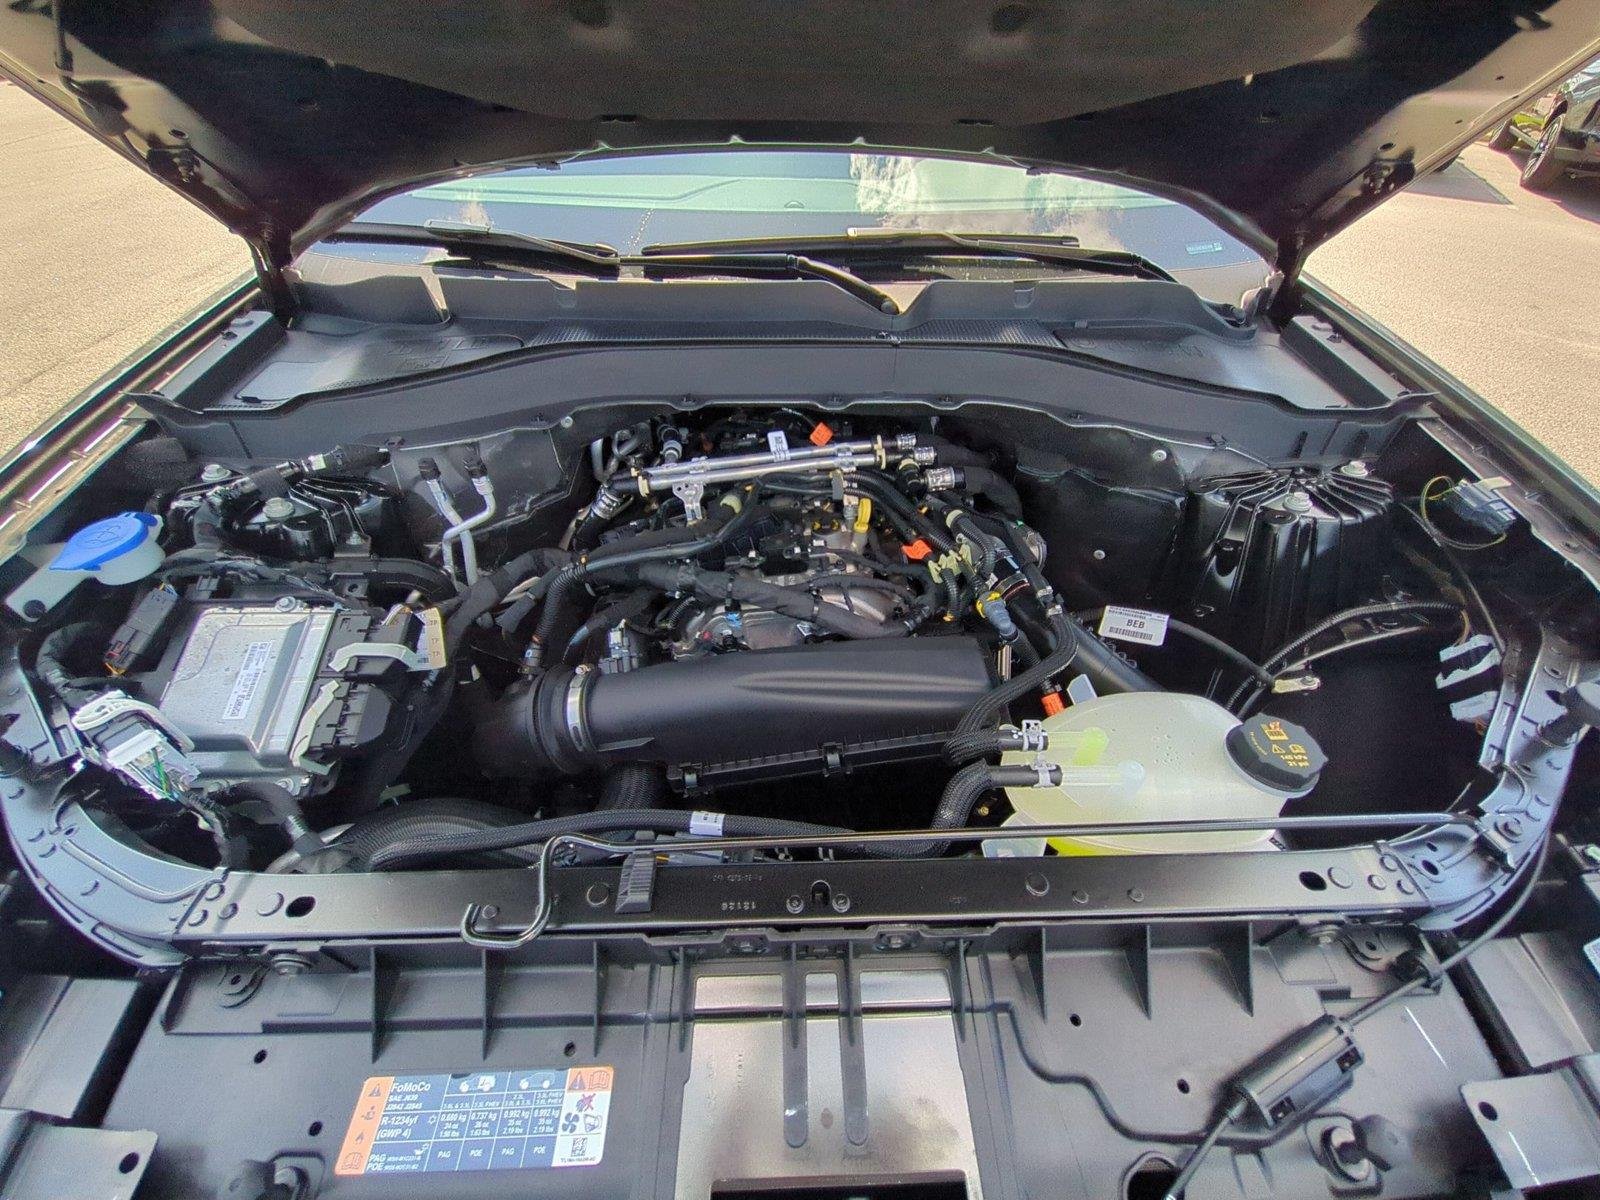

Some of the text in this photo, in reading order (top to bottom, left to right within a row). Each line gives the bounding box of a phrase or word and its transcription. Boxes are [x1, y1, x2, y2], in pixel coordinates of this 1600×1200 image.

[1126, 619, 1146, 629] BEB
[391, 1081, 431, 1092] FoMoCo
[388, 1094, 403, 1102] SAE
[488, 1112, 498, 1121] kg
[521, 1110, 530, 1119] kg
[551, 1108, 560, 1118] kg
[381, 1115, 419, 1127] R-1234yf
[458, 1113, 467, 1123] kg
[376, 1128, 412, 1140] (GWP 4)
[437, 1150, 451, 1159] PAG
[469, 1149, 483, 1157] POE
[501, 1148, 515, 1156] PAG
[533, 1146, 546, 1154] POE
[369, 1154, 387, 1163] PAG
[366, 1162, 384, 1171] POE
